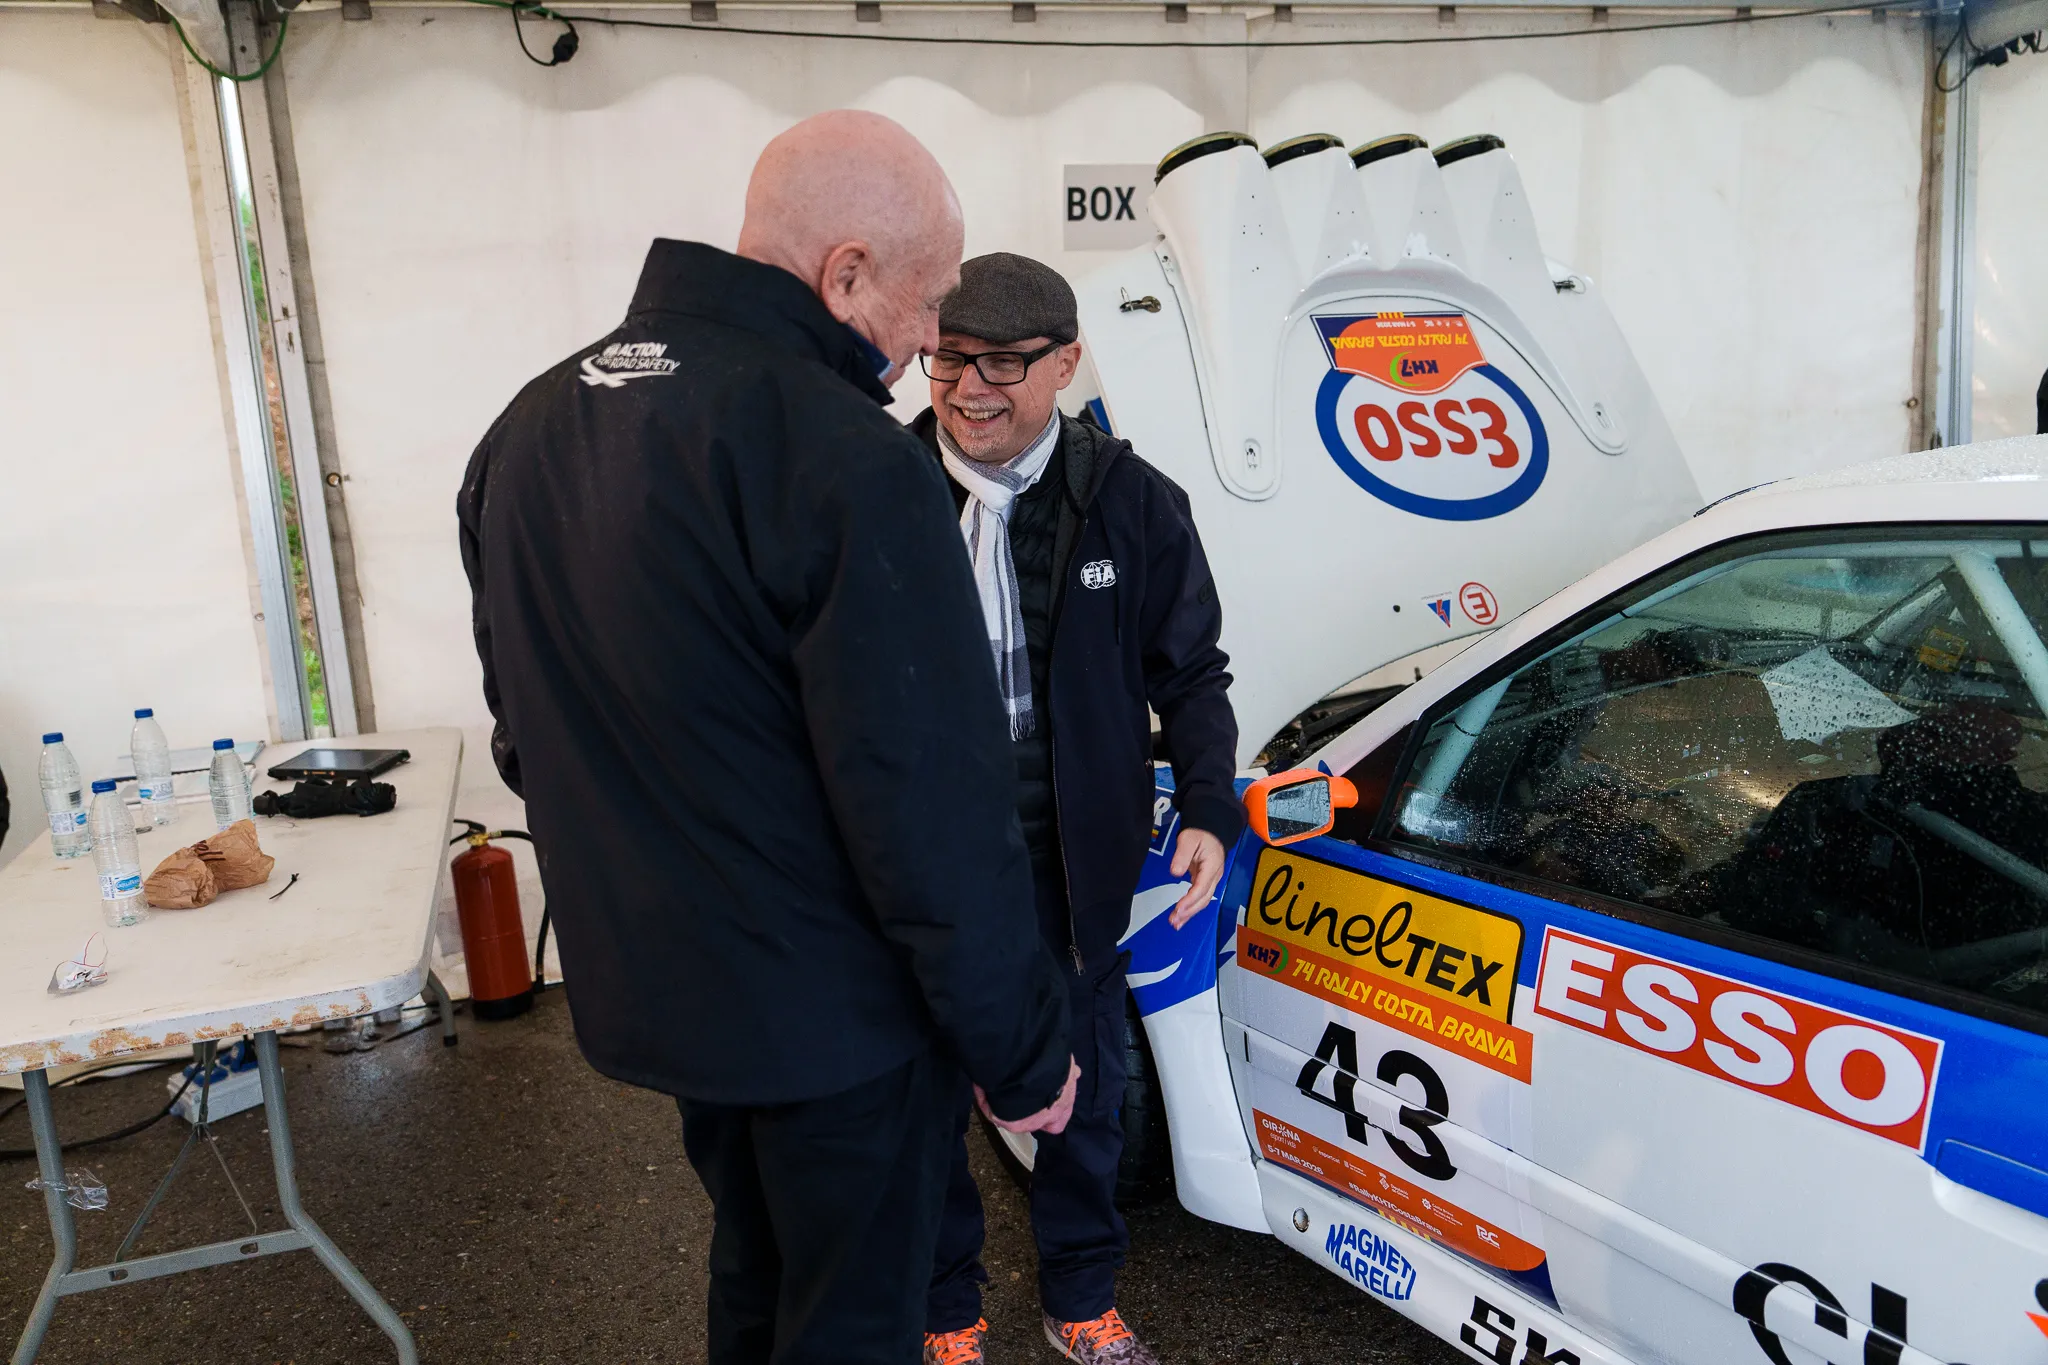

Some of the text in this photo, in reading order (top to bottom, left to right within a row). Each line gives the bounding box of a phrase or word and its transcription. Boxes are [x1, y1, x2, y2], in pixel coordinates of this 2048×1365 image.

[1067, 186, 1136, 221] BOX
[610, 358, 638, 370] ROAD
[636, 357, 681, 372] SAFETY
[617, 342, 667, 358] ACTION
[1329, 333, 1469, 350] 74 RALLY COSTA BRAVA
[1291, 959, 1518, 1066] 74 RALLY COSTA BRAVA
[1537, 934, 1926, 1126] ESSO
[1295, 1021, 1458, 1181] 43
[1266, 1144, 1324, 1175] 5-7 MAR 2026
[1325, 1223, 1417, 1285] MAGNETI
[1325, 1238, 1417, 1301] MARELLI
